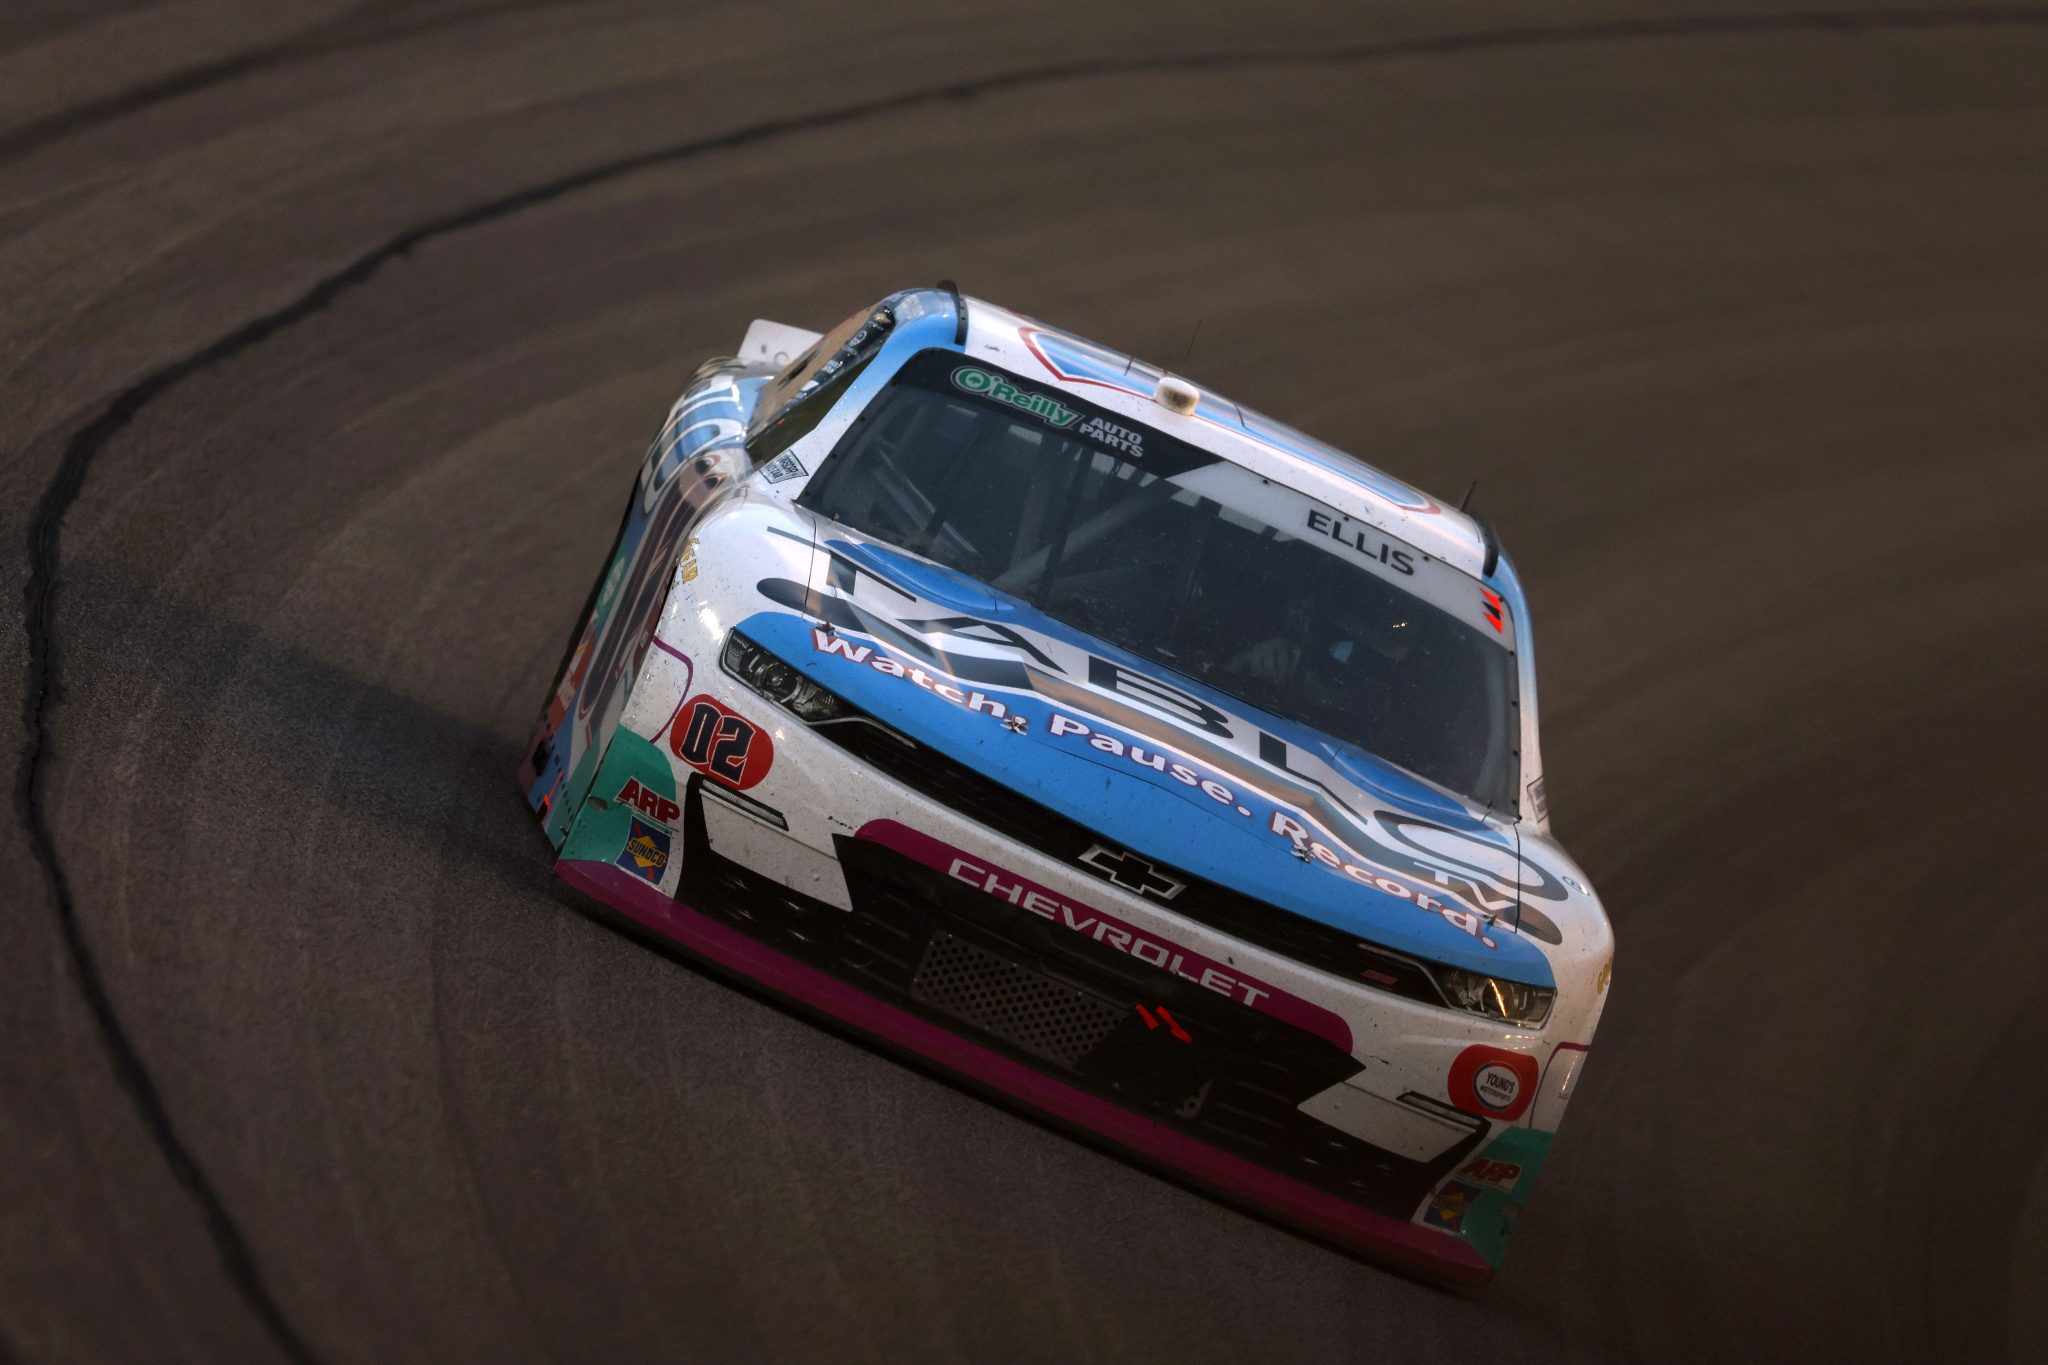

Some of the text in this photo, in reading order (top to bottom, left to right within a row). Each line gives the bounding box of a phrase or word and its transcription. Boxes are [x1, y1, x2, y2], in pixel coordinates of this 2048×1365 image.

[954, 366, 1081, 425] O'Reilly
[1080, 423, 1144, 457] PARTS
[1090, 417, 1142, 444] AUTO
[1306, 508, 1416, 577] ELLIS
[678, 701, 757, 786] 02
[616, 777, 681, 825] ARP
[627, 837, 667, 869] SUNOCO
[1048, 712, 1253, 818] Pause.
[1269, 809, 1497, 951] Record.
[948, 857, 1270, 1008] CHEVROLET
[1486, 1071, 1516, 1094] YOUNG'S
[1460, 1158, 1521, 1184] ARP
